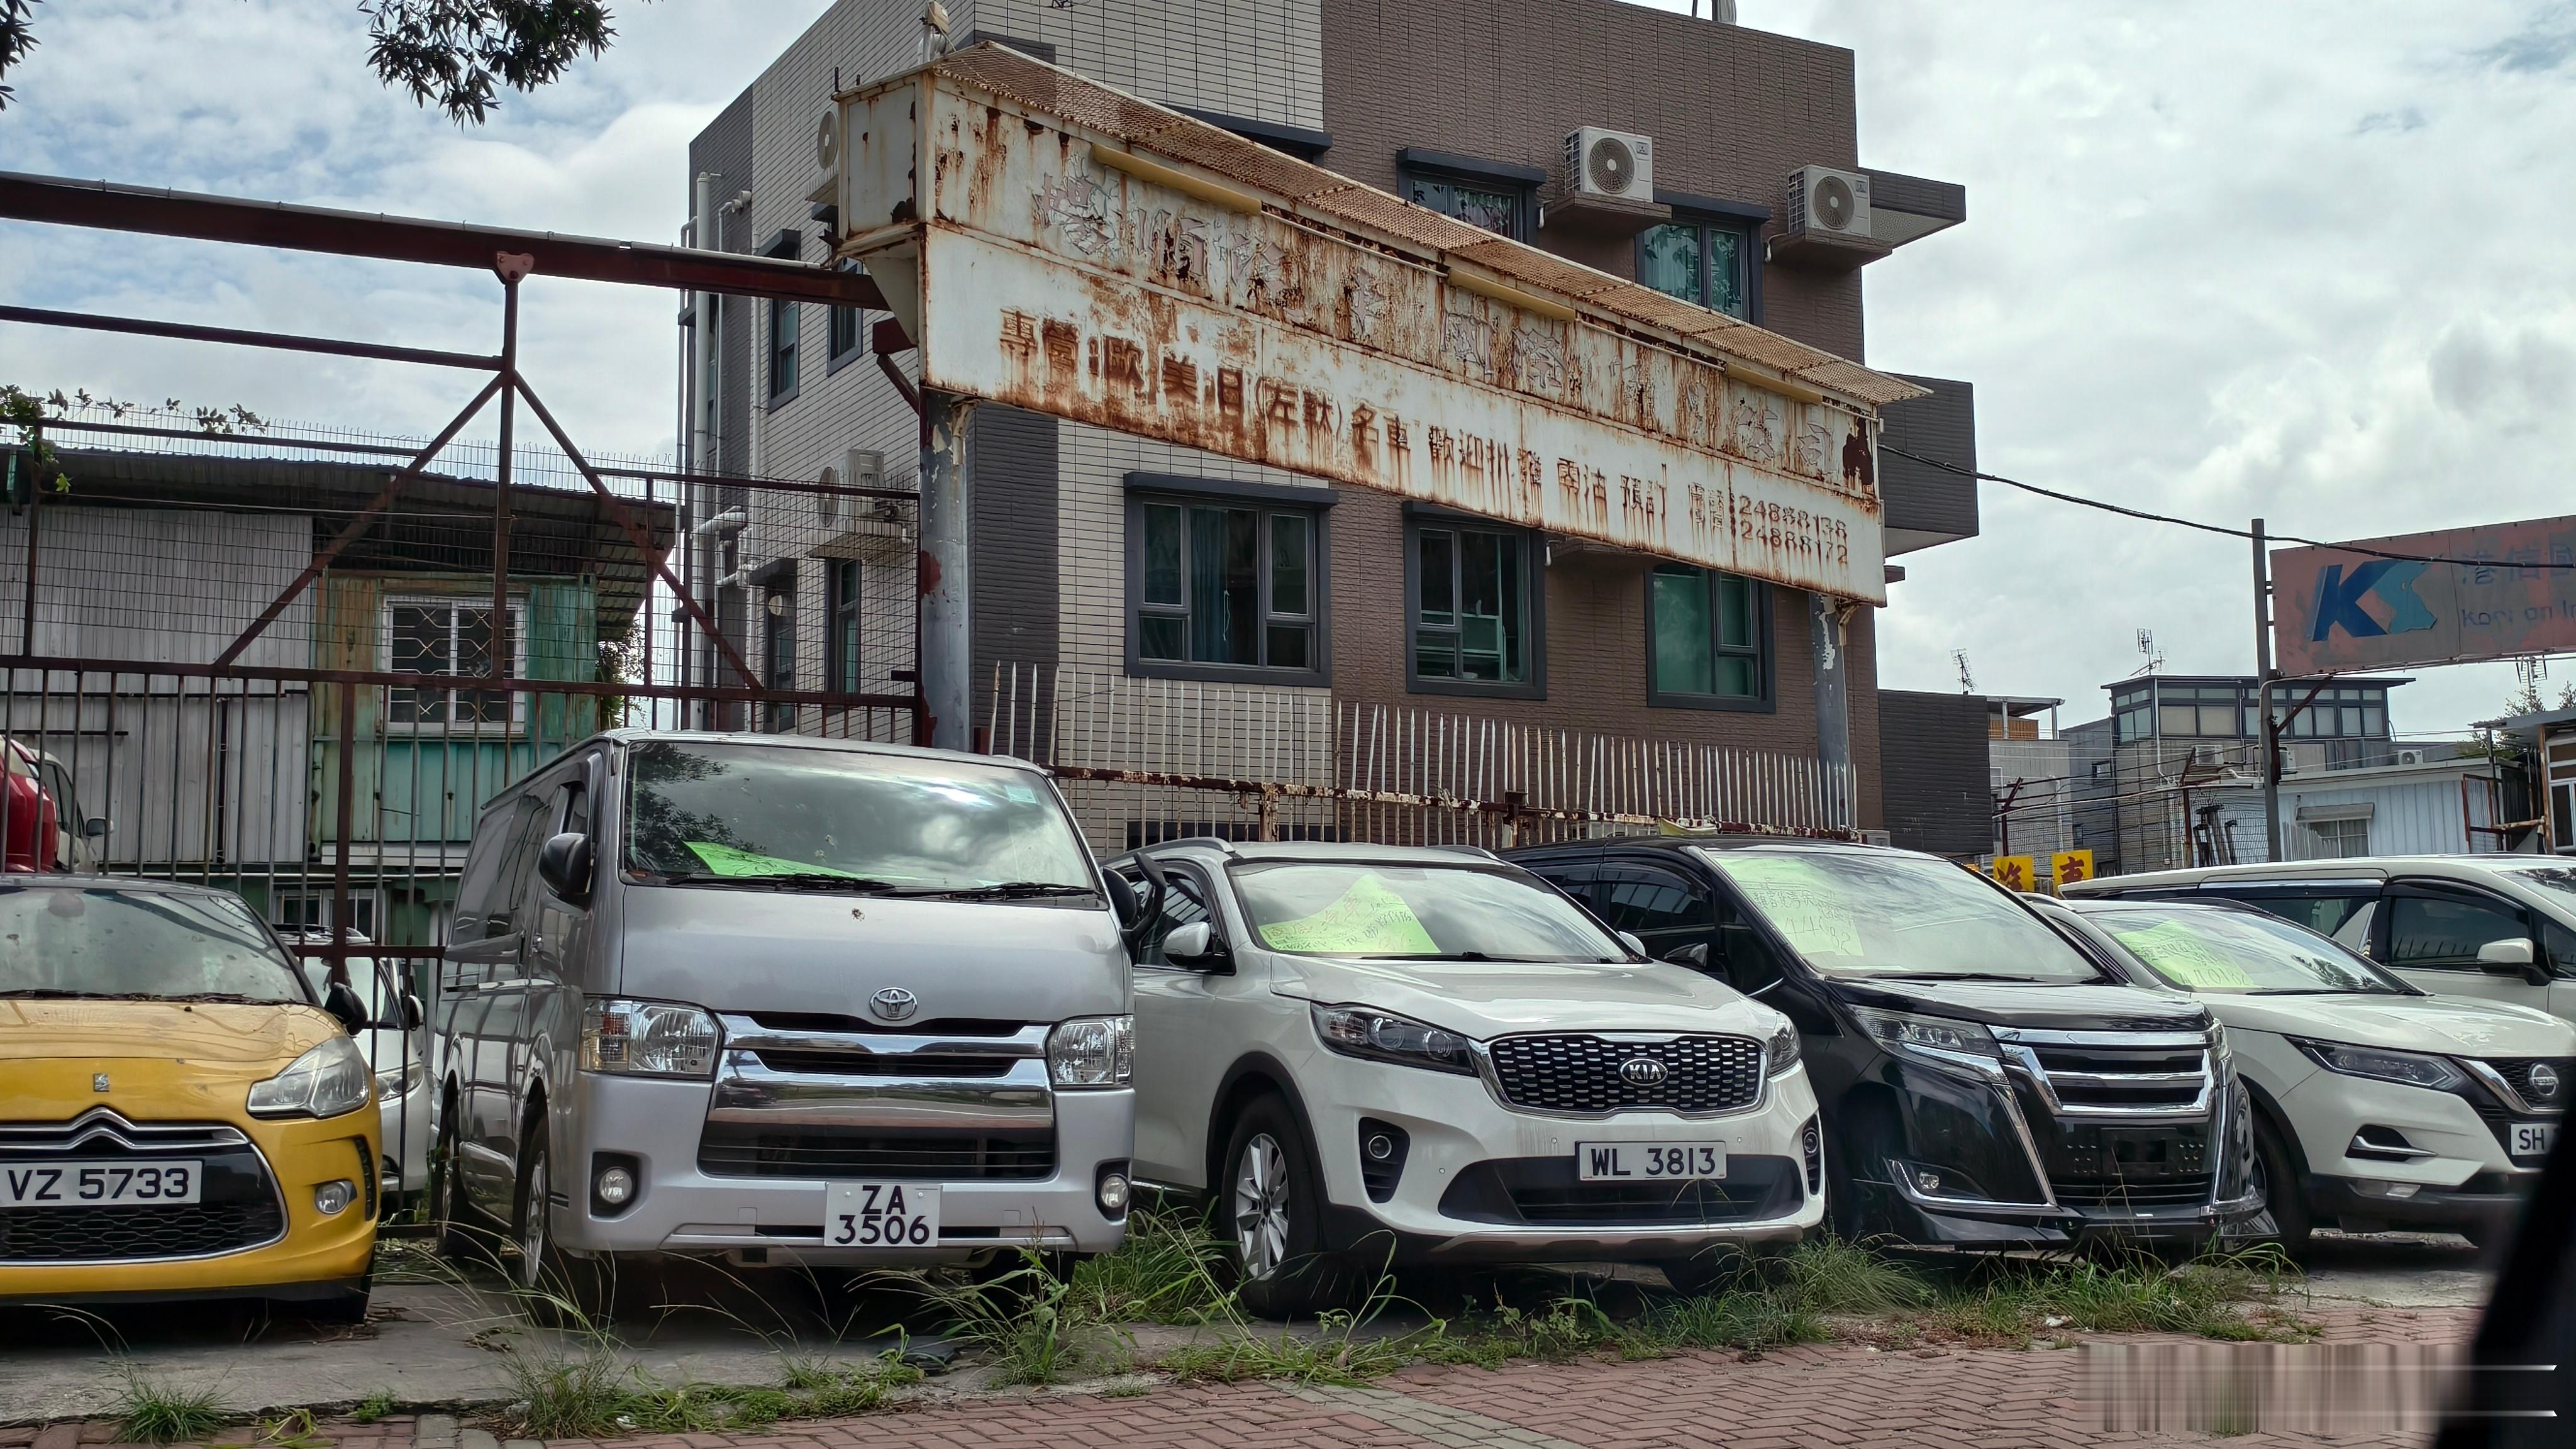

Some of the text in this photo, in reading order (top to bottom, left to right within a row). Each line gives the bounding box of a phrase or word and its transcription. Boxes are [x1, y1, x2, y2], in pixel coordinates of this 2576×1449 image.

[1629, 1064, 1662, 1080] KIA
[2519, 1128, 2545, 1150] SH
[1591, 1148, 1716, 1176] WL 3813
[8, 1168, 189, 1201] VZ 5733
[860, 1185, 906, 1215] ZA
[834, 1214, 930, 1245] 3506
